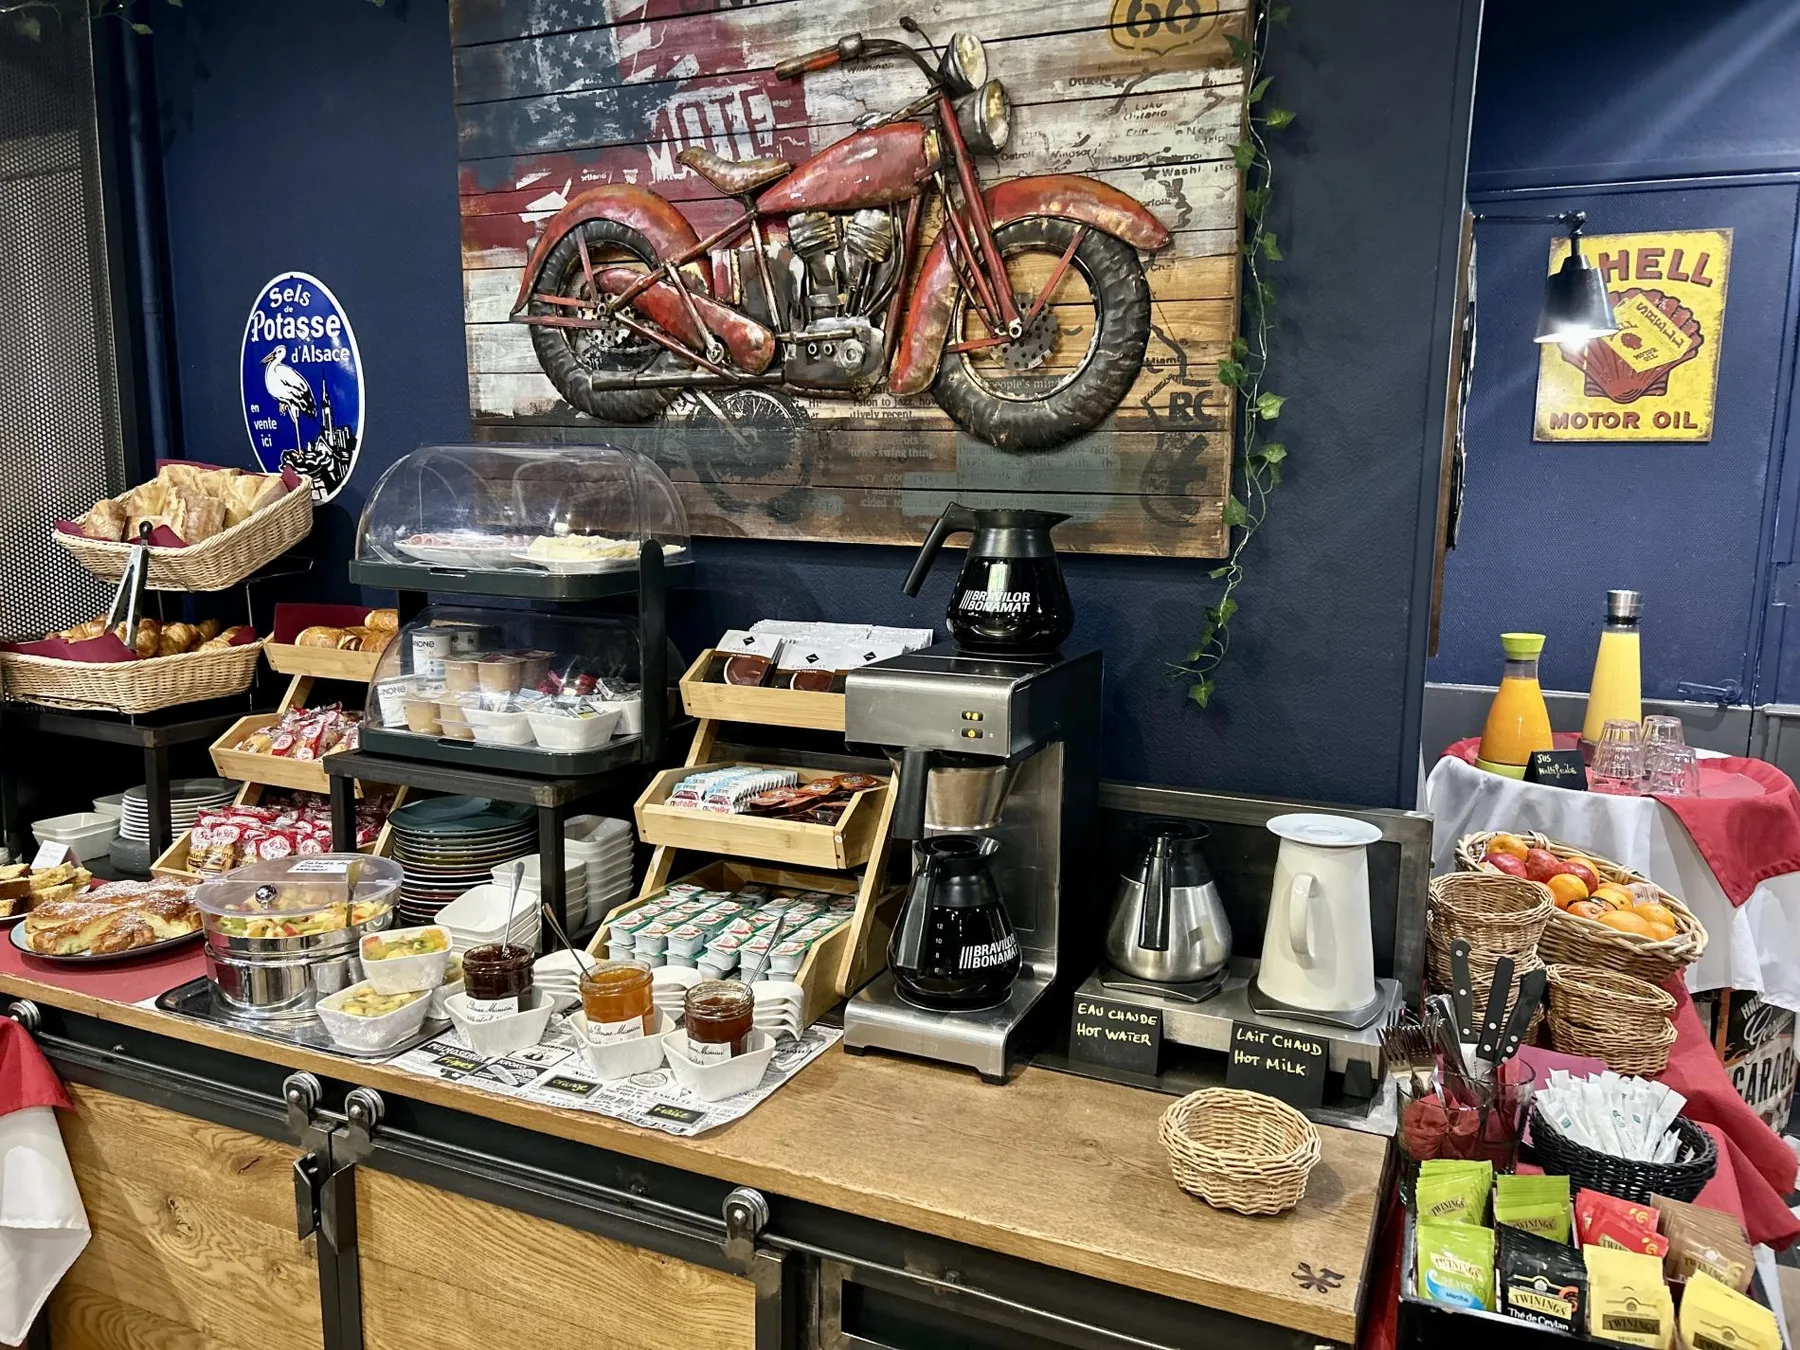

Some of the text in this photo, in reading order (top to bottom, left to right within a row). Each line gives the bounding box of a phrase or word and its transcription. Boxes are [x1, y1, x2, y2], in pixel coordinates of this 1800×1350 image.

[1598, 247, 1713, 288] HELL
[269, 283, 312, 308] Sels
[283, 305, 294, 313] de
[251, 310, 341, 342] Potasse
[291, 344, 351, 363] d'Alsace
[250, 404, 260, 413] en
[253, 416, 278, 430] vente
[1549, 410, 1699, 430] MOTOR OIL
[260, 433, 273, 448] ici
[972, 590, 1031, 603] BRAVILOR
[967, 601, 1031, 613] BONAMAT
[973, 934, 1017, 958] BRAVILOR
[972, 944, 1019, 969] BONAMAT
[1077, 1003, 1104, 1016] EAU
[1076, 1022, 1151, 1046] HOT WATER
[1271, 1034, 1322, 1056] CHAUD
[1234, 1049, 1260, 1066] HOT
[1513, 1294, 1568, 1316] TWININGS
[1508, 1307, 1526, 1318] Thé
[1526, 1312, 1537, 1322] de
[1607, 1319, 1659, 1333] TWININGS
